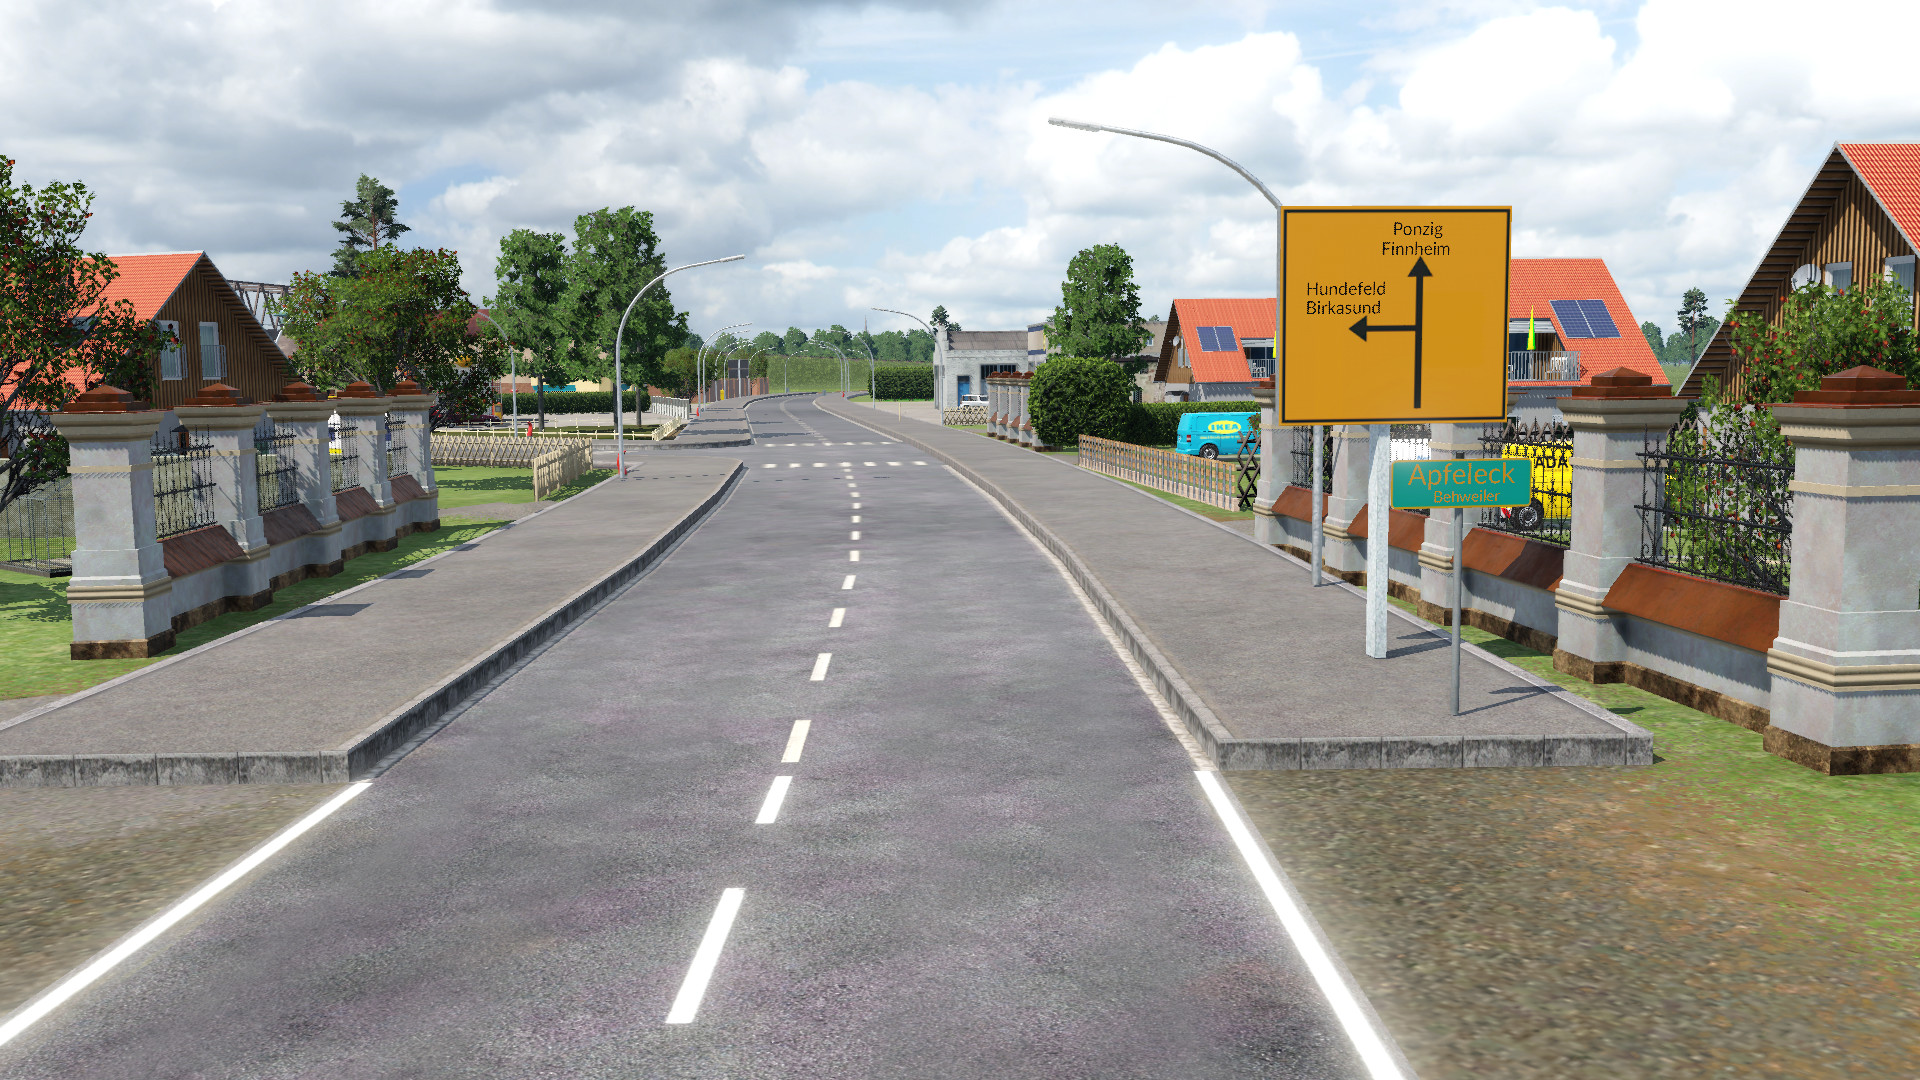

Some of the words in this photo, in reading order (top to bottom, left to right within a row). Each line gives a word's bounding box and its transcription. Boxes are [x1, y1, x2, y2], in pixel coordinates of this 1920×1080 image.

[1394, 222, 1443, 239] Ponzig
[1382, 242, 1450, 256] Finnheim
[1307, 282, 1386, 296] Hundefeld
[1306, 301, 1381, 315] Birkasund
[1407, 462, 1516, 491] Apfeleck
[1433, 490, 1500, 504] Behweiler
